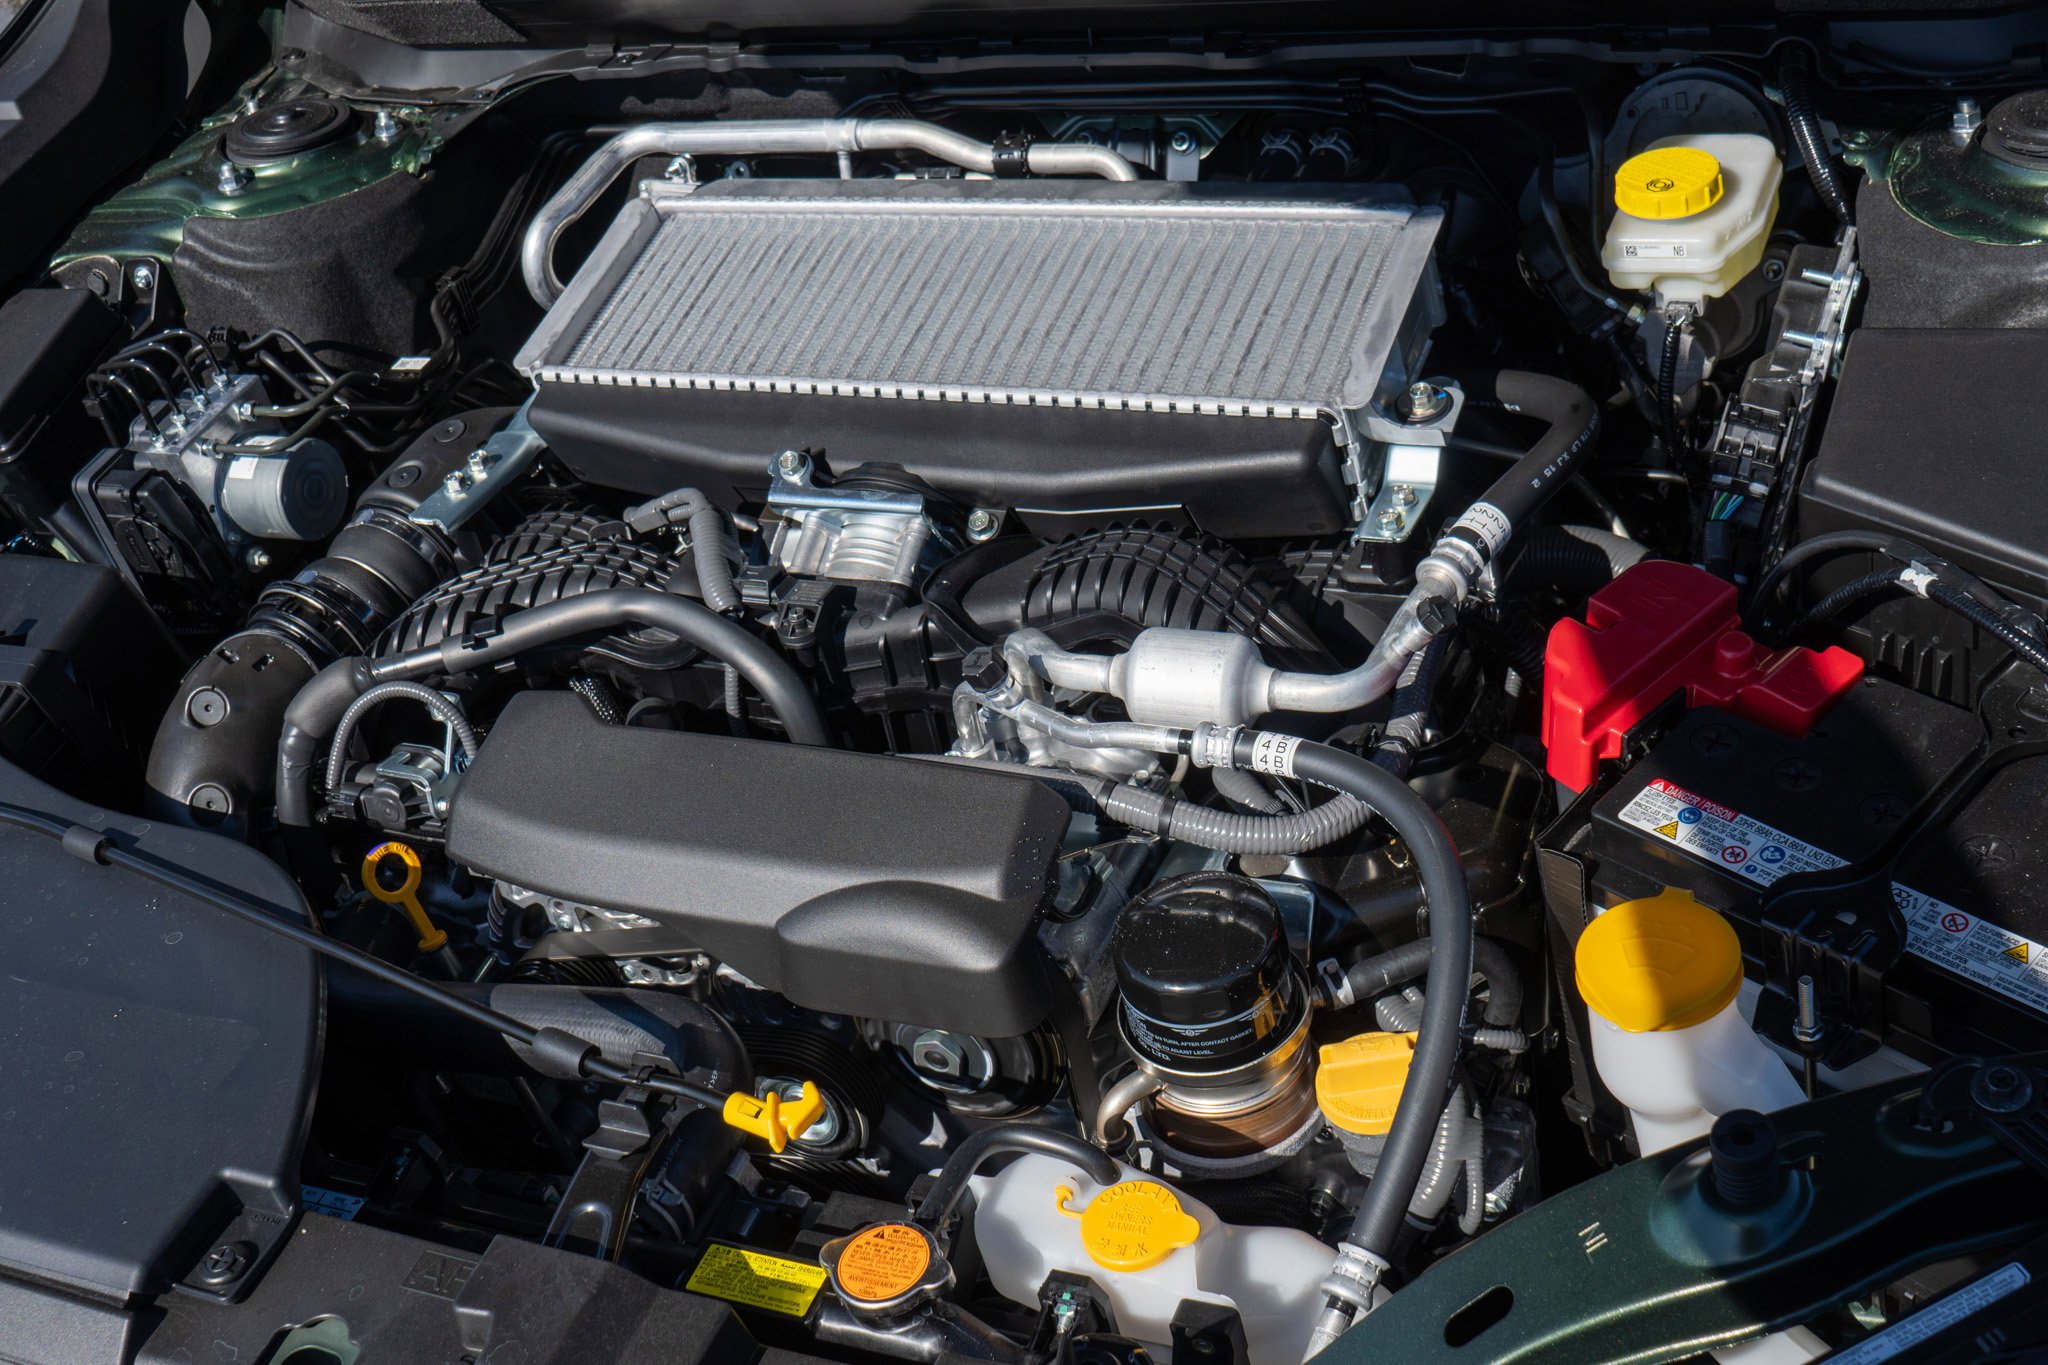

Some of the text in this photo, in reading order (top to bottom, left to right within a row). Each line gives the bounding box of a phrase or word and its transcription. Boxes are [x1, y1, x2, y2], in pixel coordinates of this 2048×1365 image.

[1665, 785, 1700, 805] DANGER
[1704, 802, 1735, 820] POISON
[1772, 832, 1789, 846] CCA
[1200, 1038, 1229, 1047] CONTACT
[1108, 1221, 1150, 1236] MANUAL
